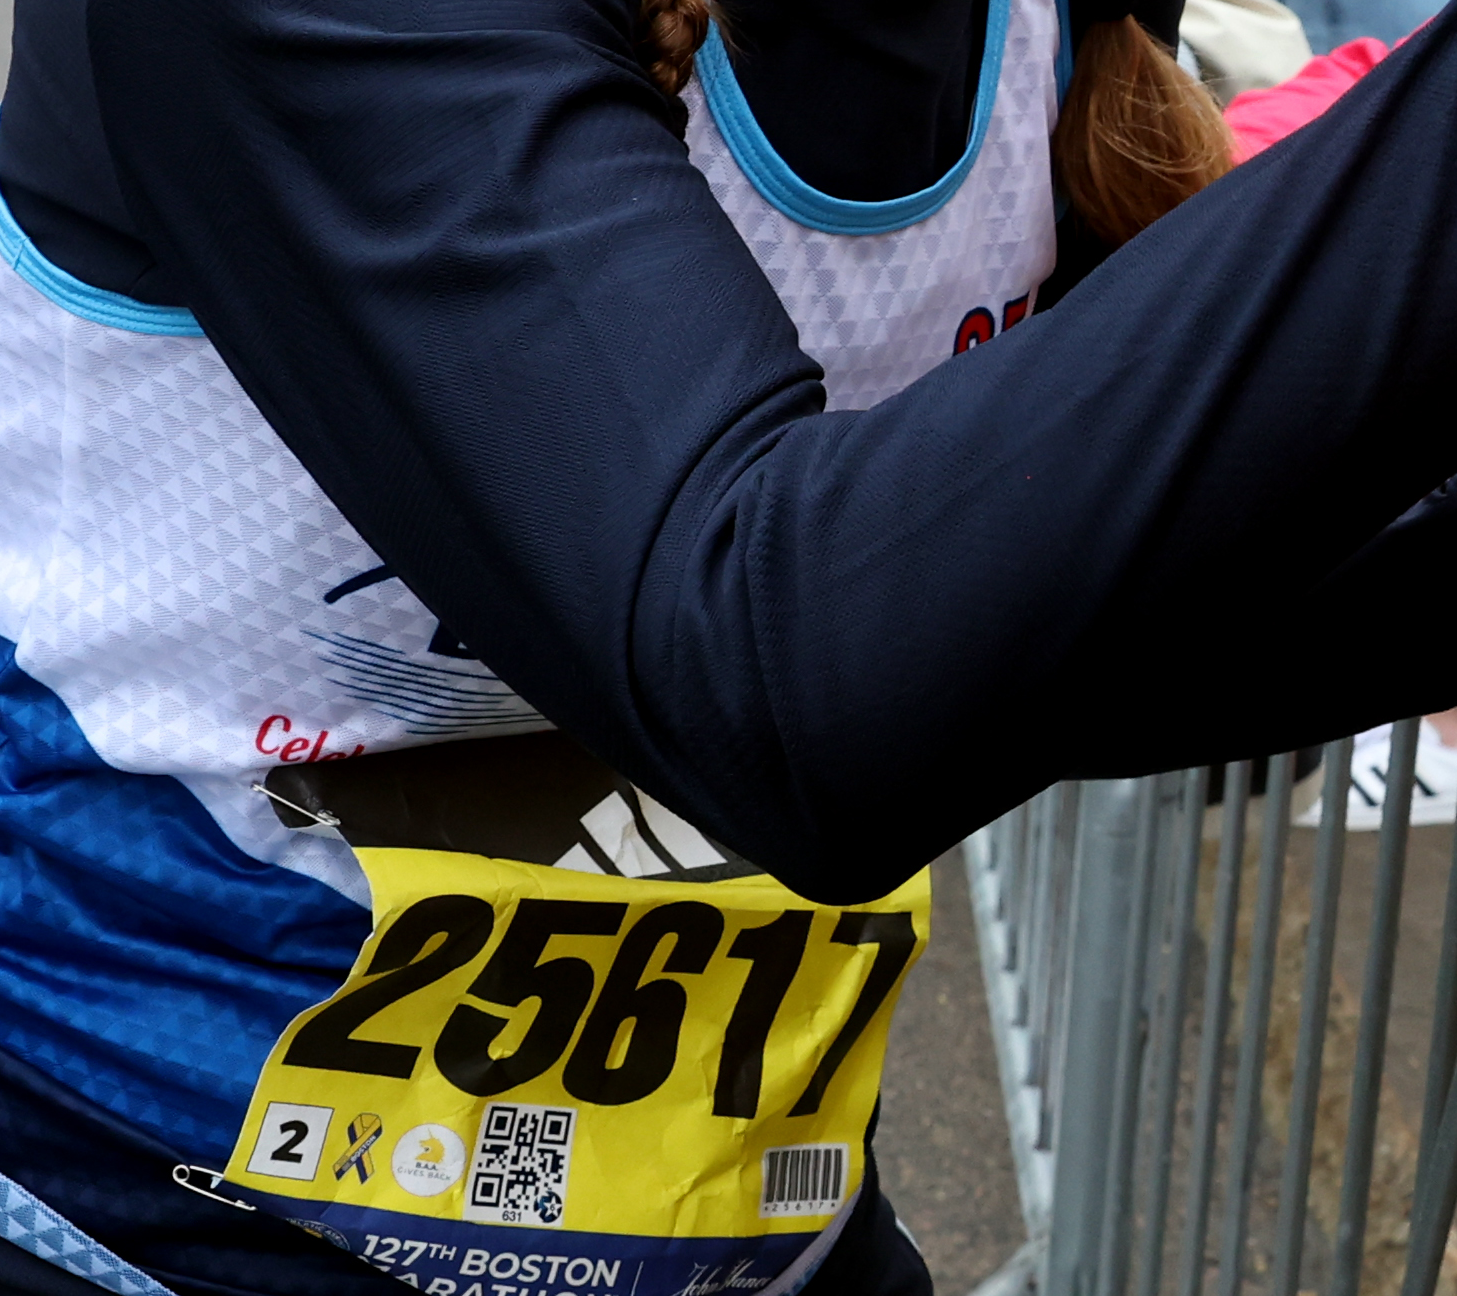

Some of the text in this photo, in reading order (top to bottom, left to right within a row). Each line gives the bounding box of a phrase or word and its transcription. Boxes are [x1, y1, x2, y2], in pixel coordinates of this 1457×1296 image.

[255, 714, 366, 763] Cel
[282, 894, 918, 1120] 25617
[270, 1120, 309, 1164] 2
[502, 1210, 522, 1223] 631
[363, 1234, 457, 1268] 127TH
[459, 1248, 621, 1288] BOSTON
